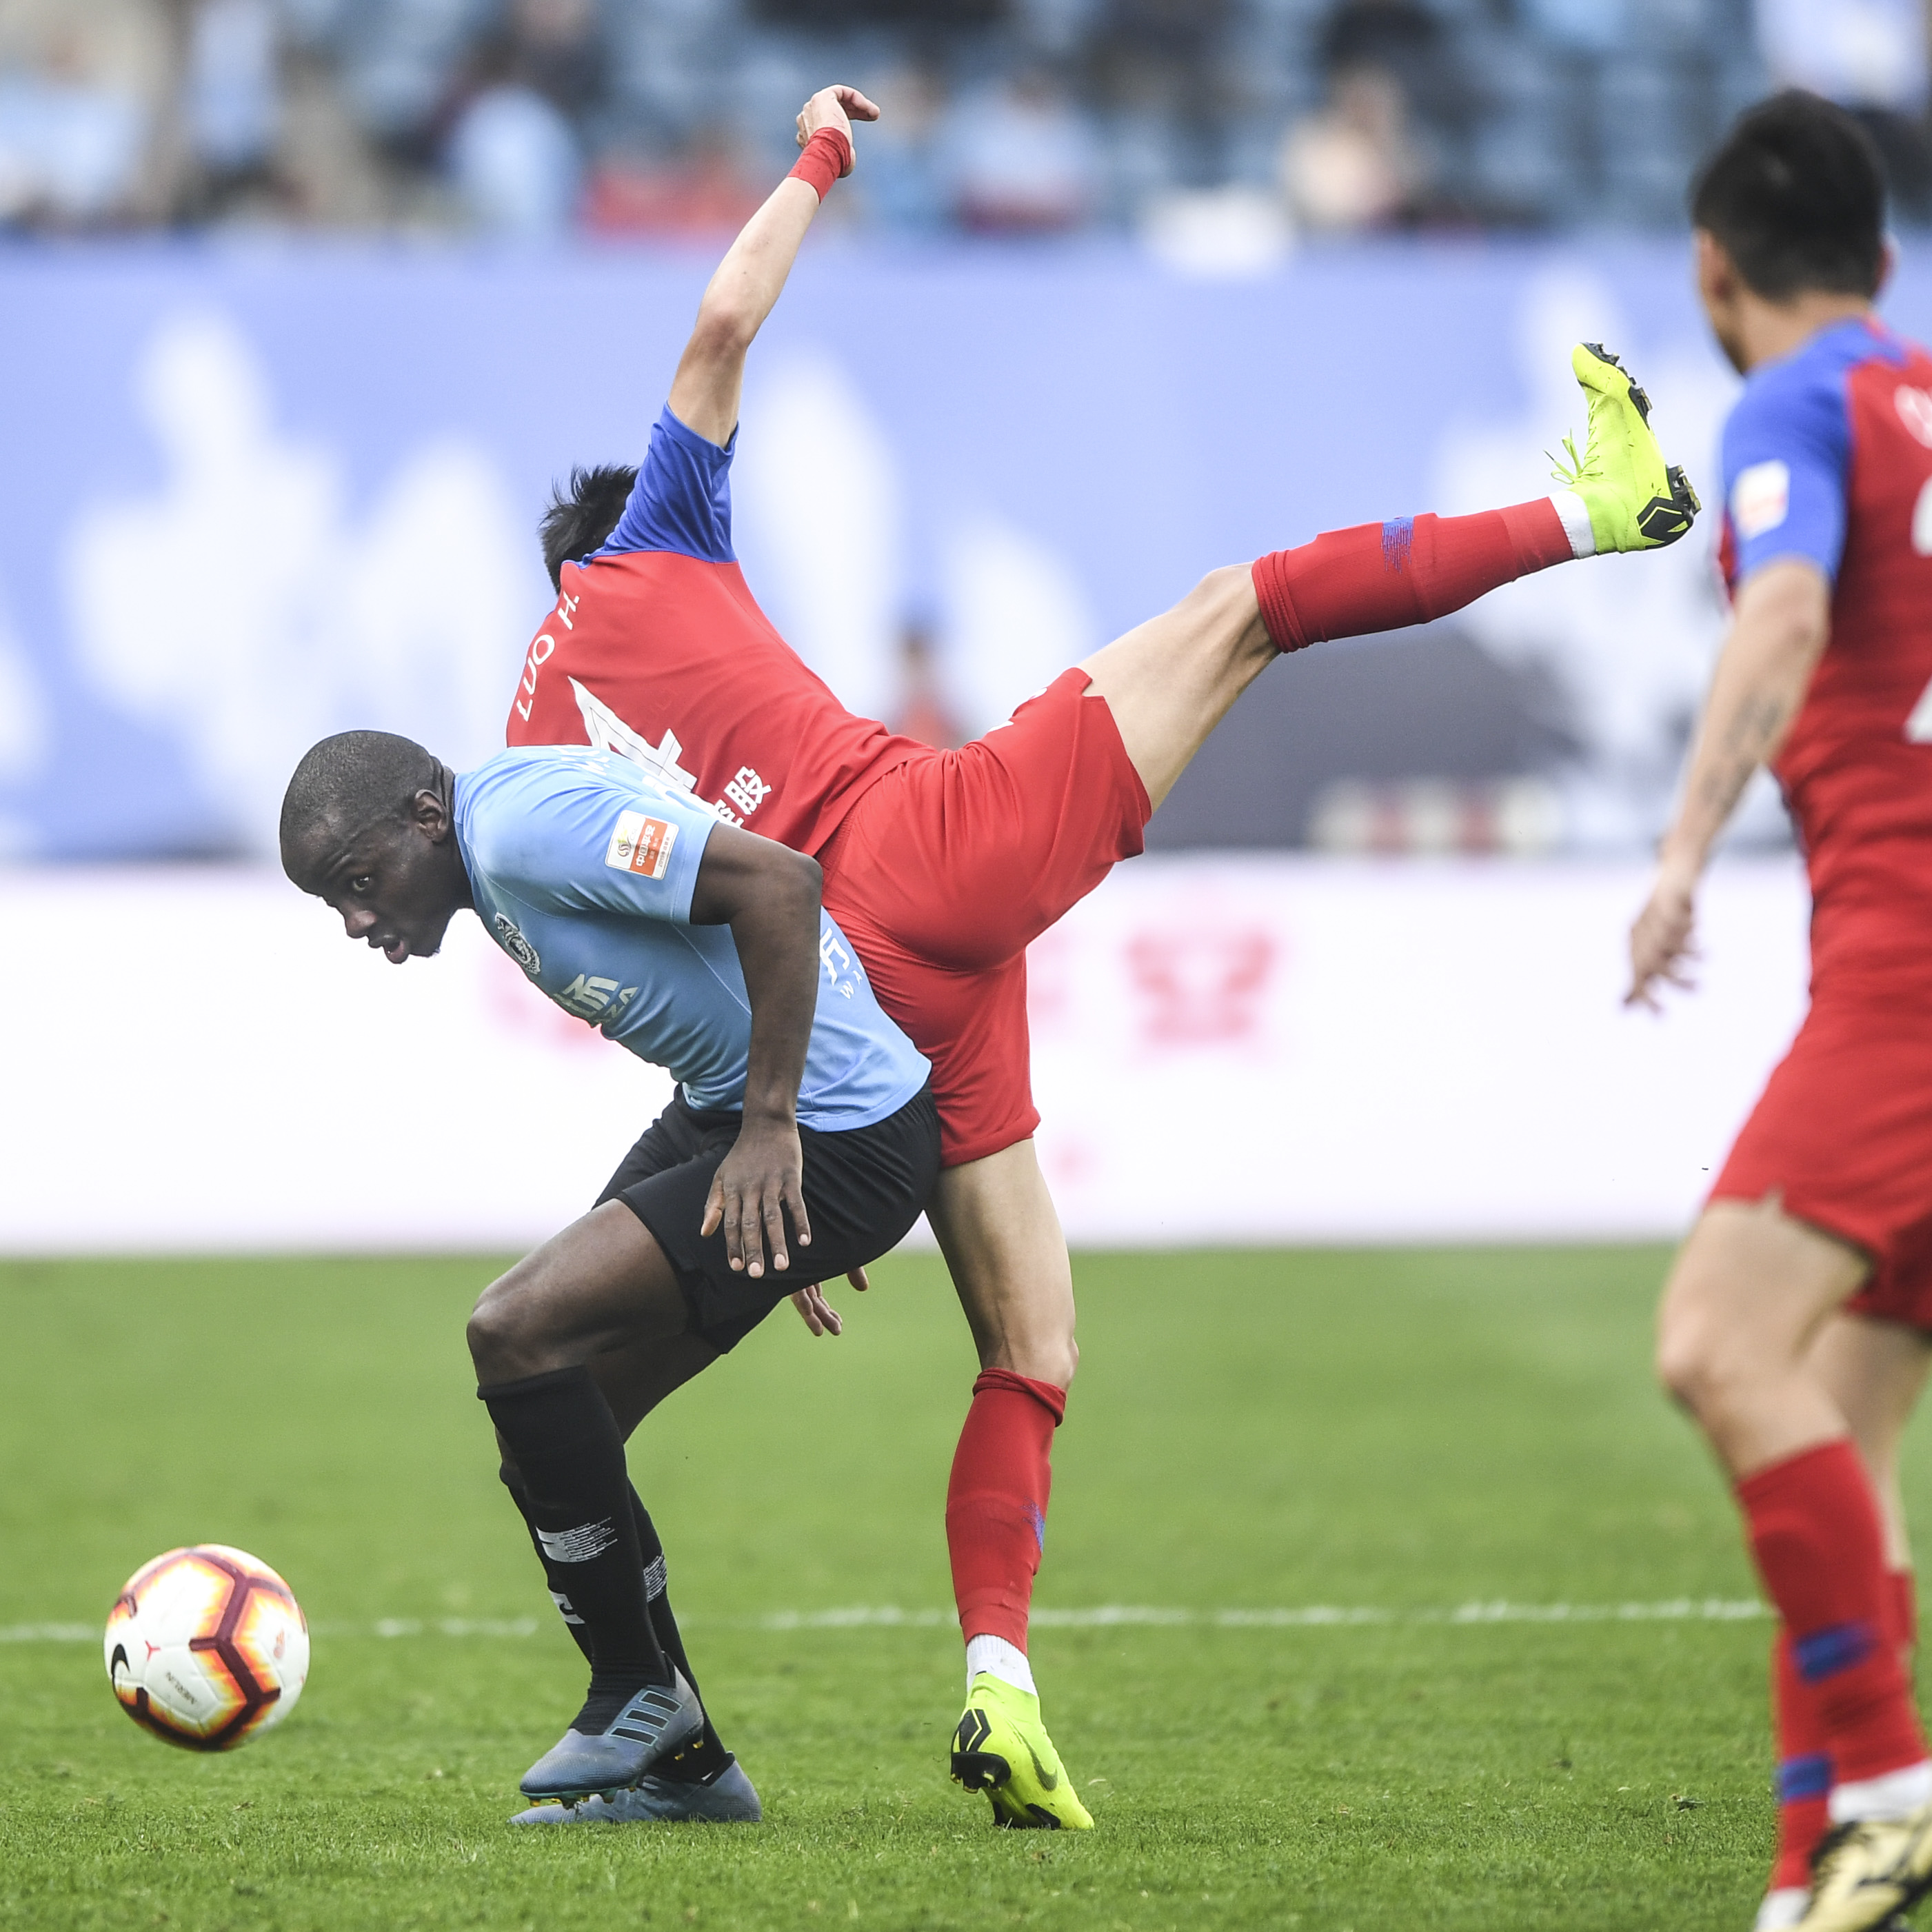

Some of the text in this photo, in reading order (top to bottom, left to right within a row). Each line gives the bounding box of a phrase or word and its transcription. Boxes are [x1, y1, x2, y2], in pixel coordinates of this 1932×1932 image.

[516, 590, 580, 722] LUO H.
[567, 674, 698, 793] 4
[636, 824, 656, 867] 中国平安
